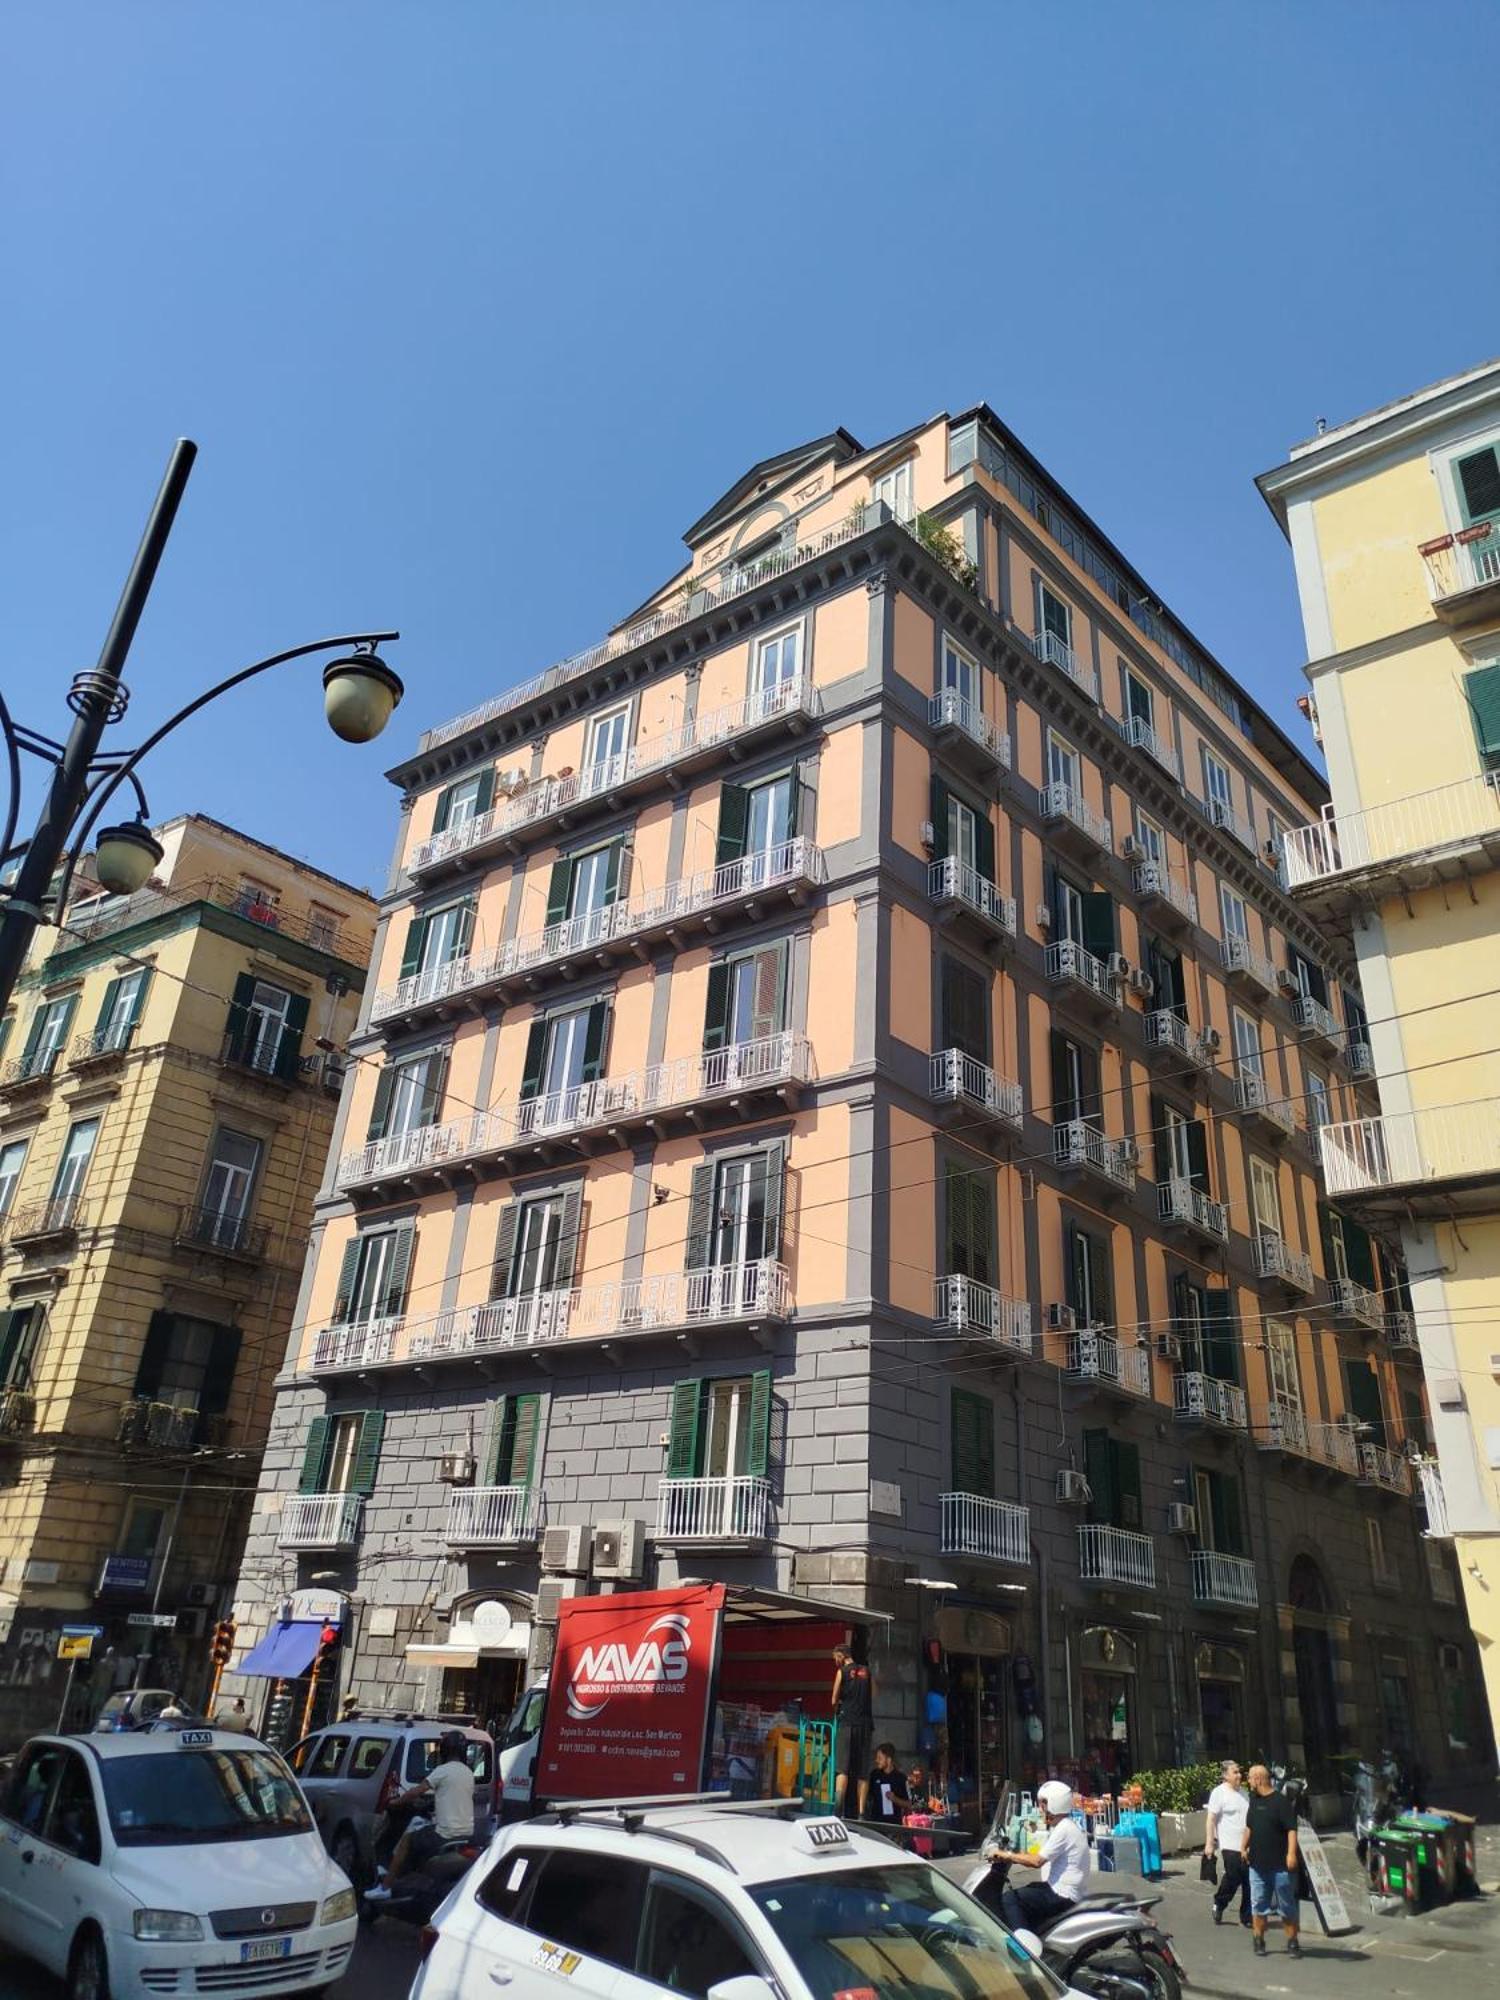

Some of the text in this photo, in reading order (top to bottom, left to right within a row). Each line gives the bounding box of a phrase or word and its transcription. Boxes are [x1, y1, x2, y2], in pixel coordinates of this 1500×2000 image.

[571, 1640, 689, 1682] NAVAS
[610, 1683, 655, 1694] DISTRIBUZIONE
[656, 1683, 686, 1694] BEVANDE
[182, 1733, 211, 1744] TAXI
[807, 1824, 846, 1843] TAXI
